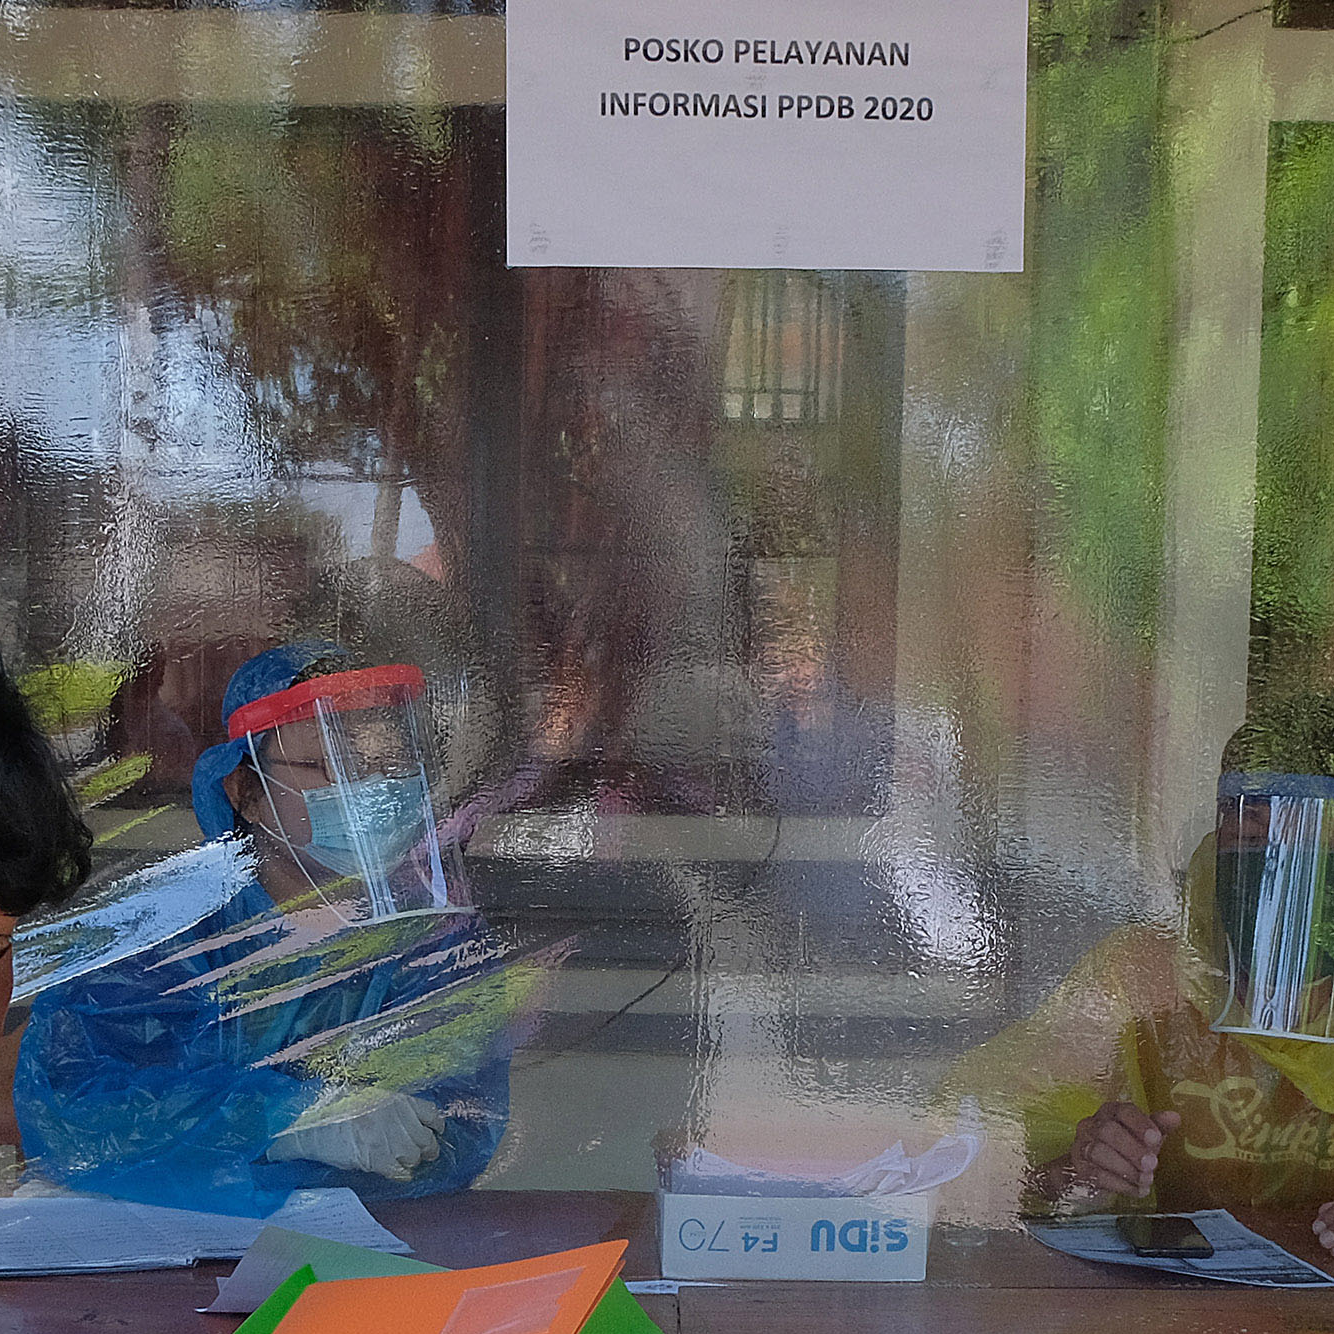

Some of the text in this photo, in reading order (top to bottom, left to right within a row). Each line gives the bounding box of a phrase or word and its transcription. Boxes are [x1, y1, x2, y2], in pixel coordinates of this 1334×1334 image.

[623, 37, 910, 67] POSKO PELAYANAN
[599, 92, 934, 122] INFORMASI PPDB 2020
[678, 1218, 730, 1251] 70
[741, 1231, 779, 1253] F4
